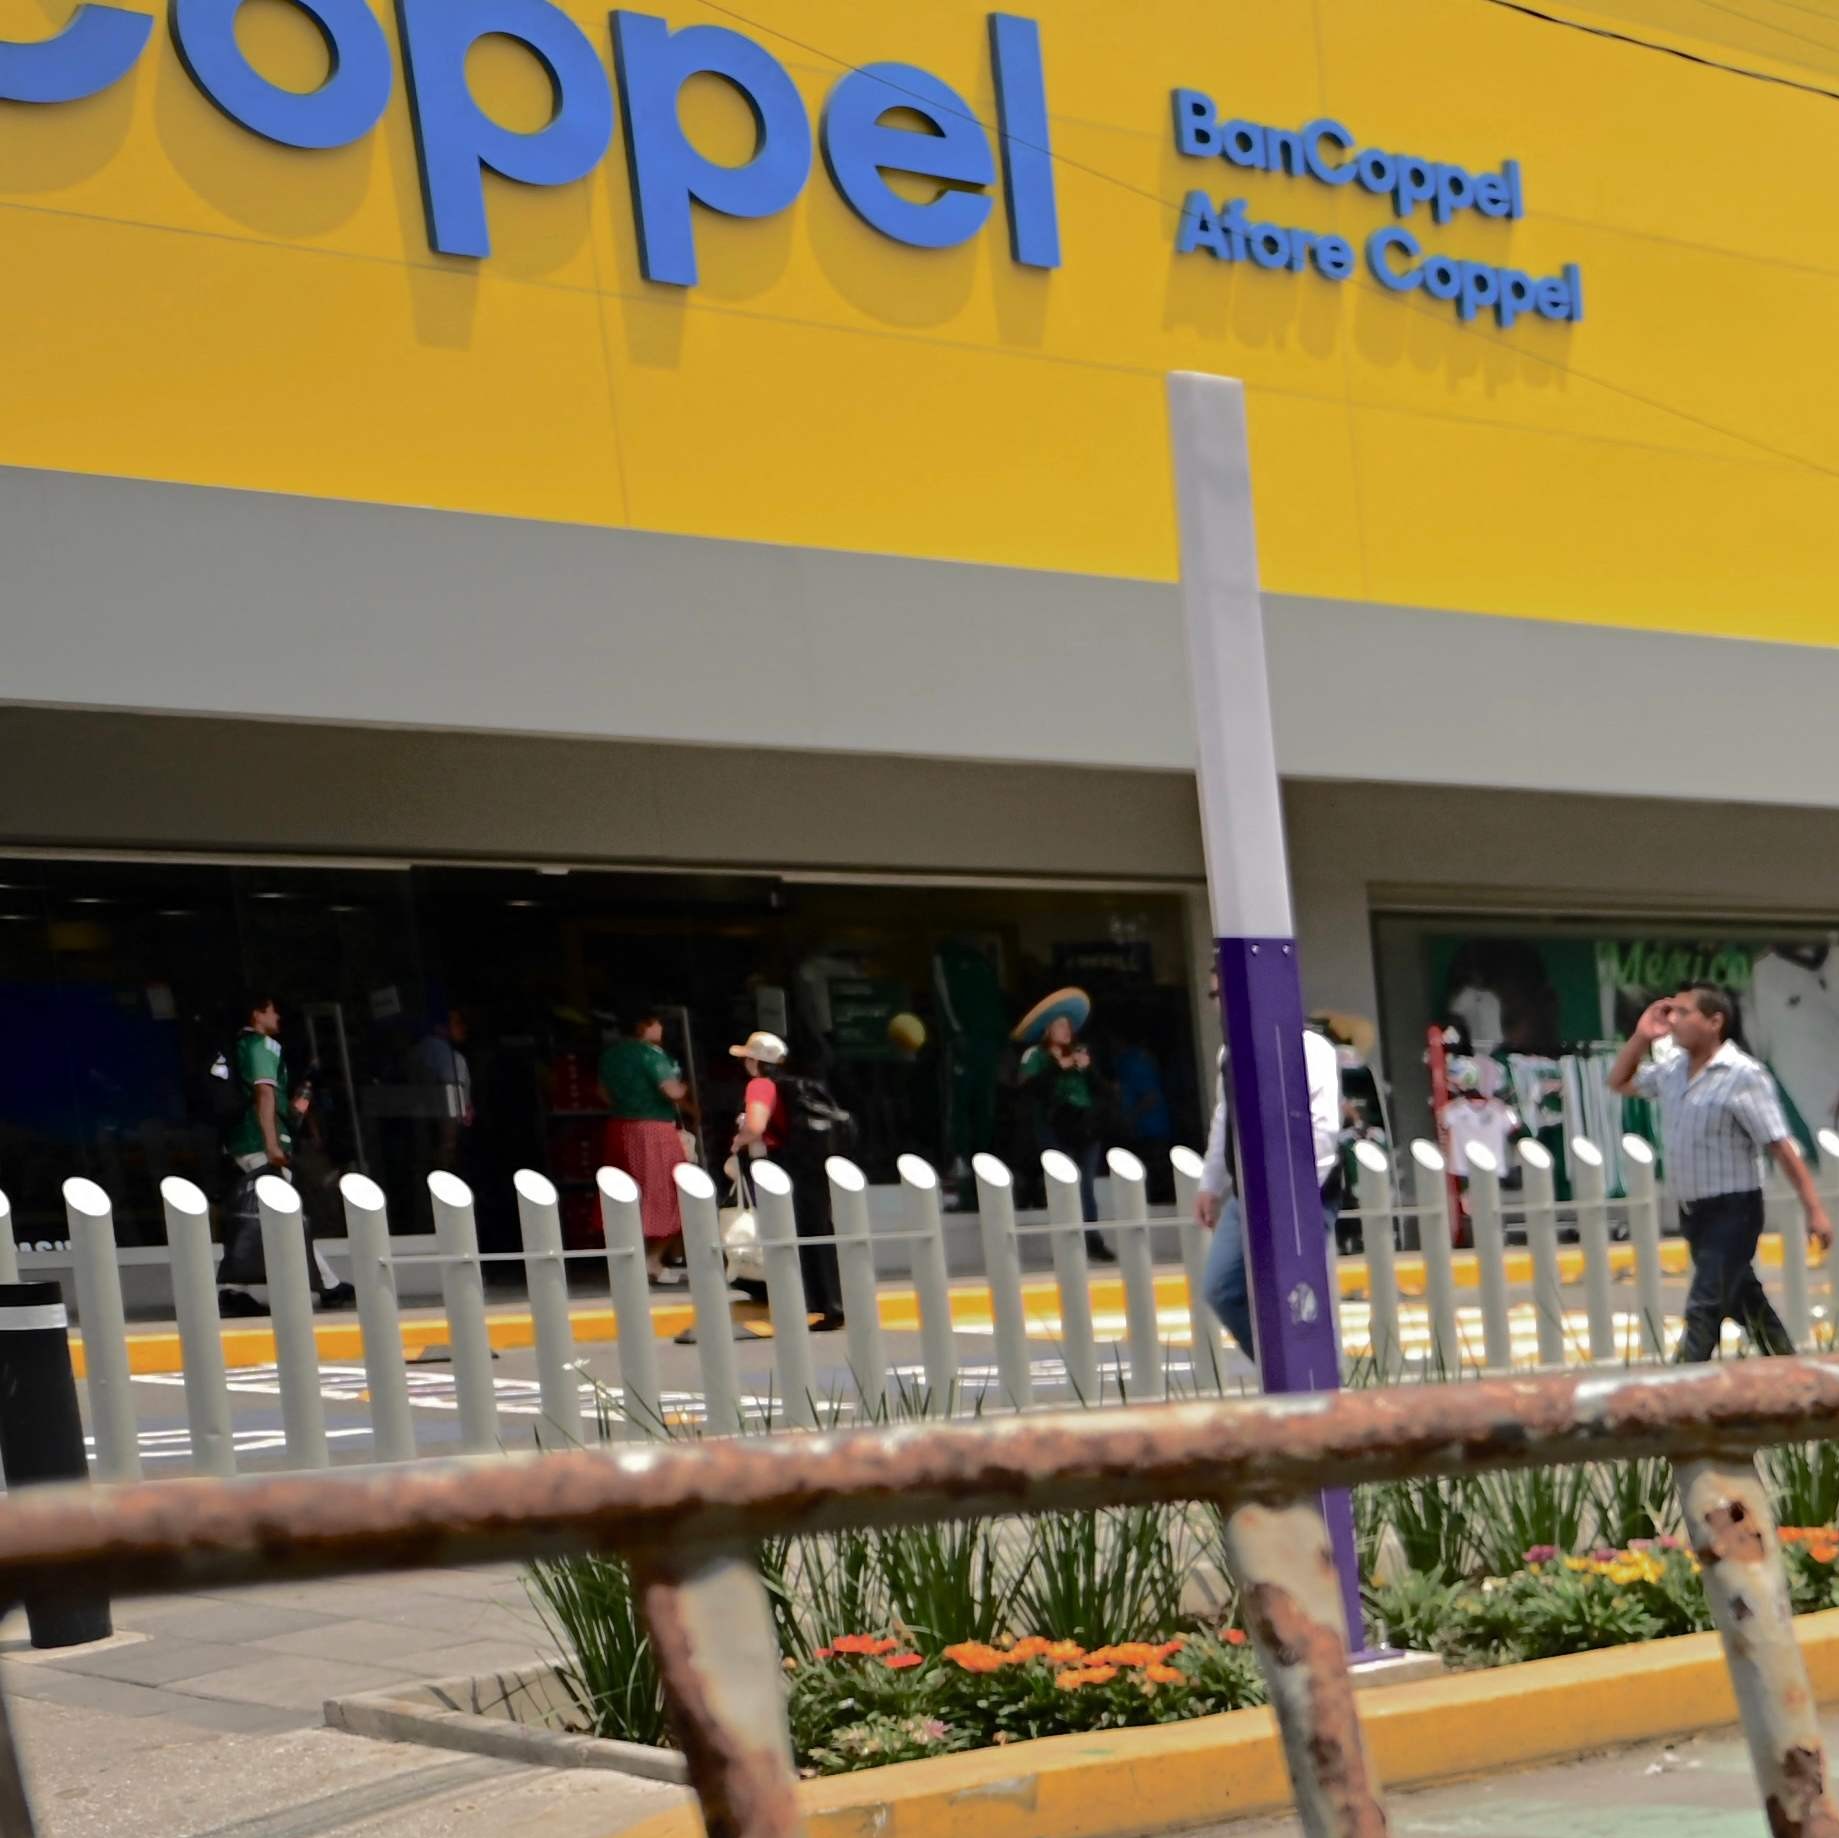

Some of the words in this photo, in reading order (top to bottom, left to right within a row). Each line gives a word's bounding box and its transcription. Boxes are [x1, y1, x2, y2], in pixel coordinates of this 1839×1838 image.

[1171, 87, 1524, 224] BanCoppel
[1177, 190, 1355, 280] Afore
[1366, 226, 1582, 328] Coppel
